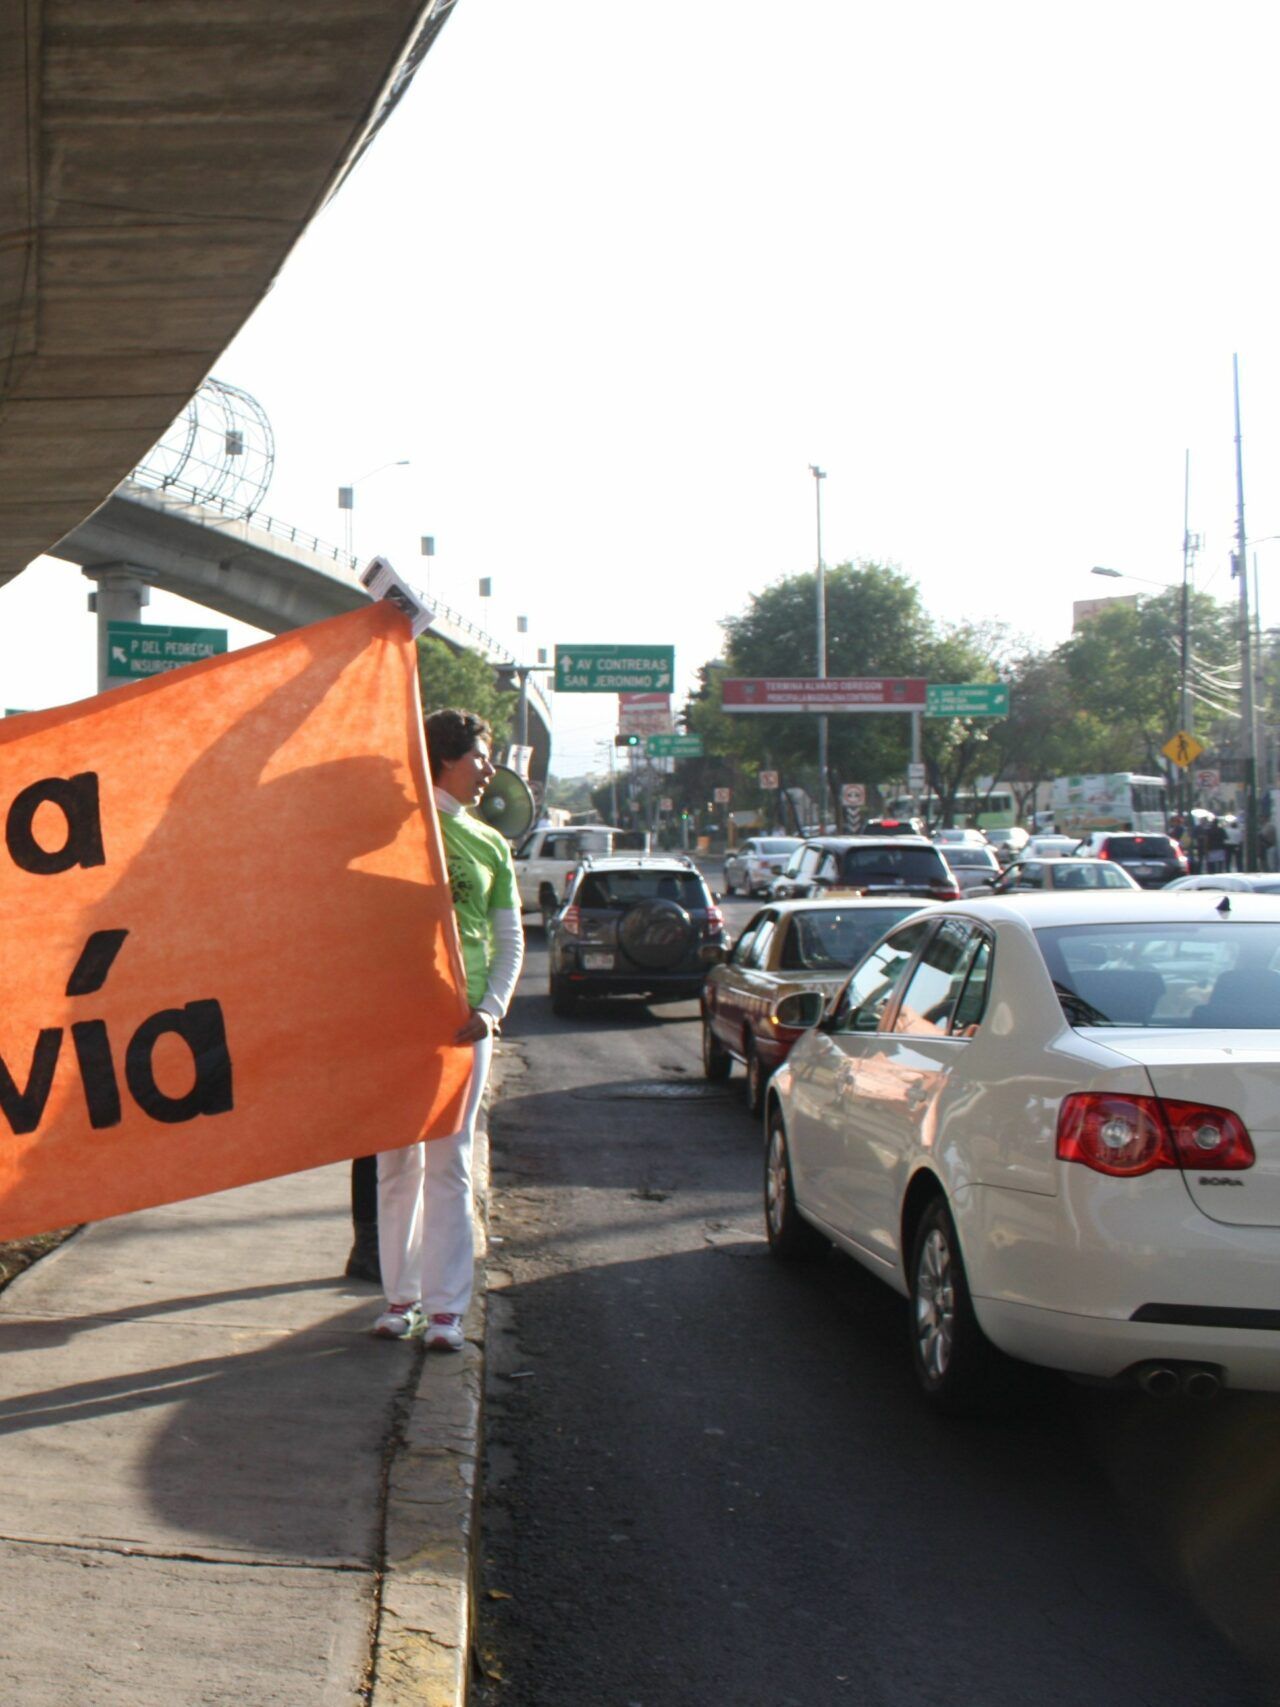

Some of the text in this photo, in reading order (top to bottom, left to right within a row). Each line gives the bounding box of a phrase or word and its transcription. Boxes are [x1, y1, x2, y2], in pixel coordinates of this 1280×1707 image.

[131, 640, 215, 657] P DEL PEDREGAL
[577, 658, 668, 671] AV CONTRERAS
[564, 676, 652, 688] SAN JERONIMO
[1198, 1176, 1244, 1187] BORA
